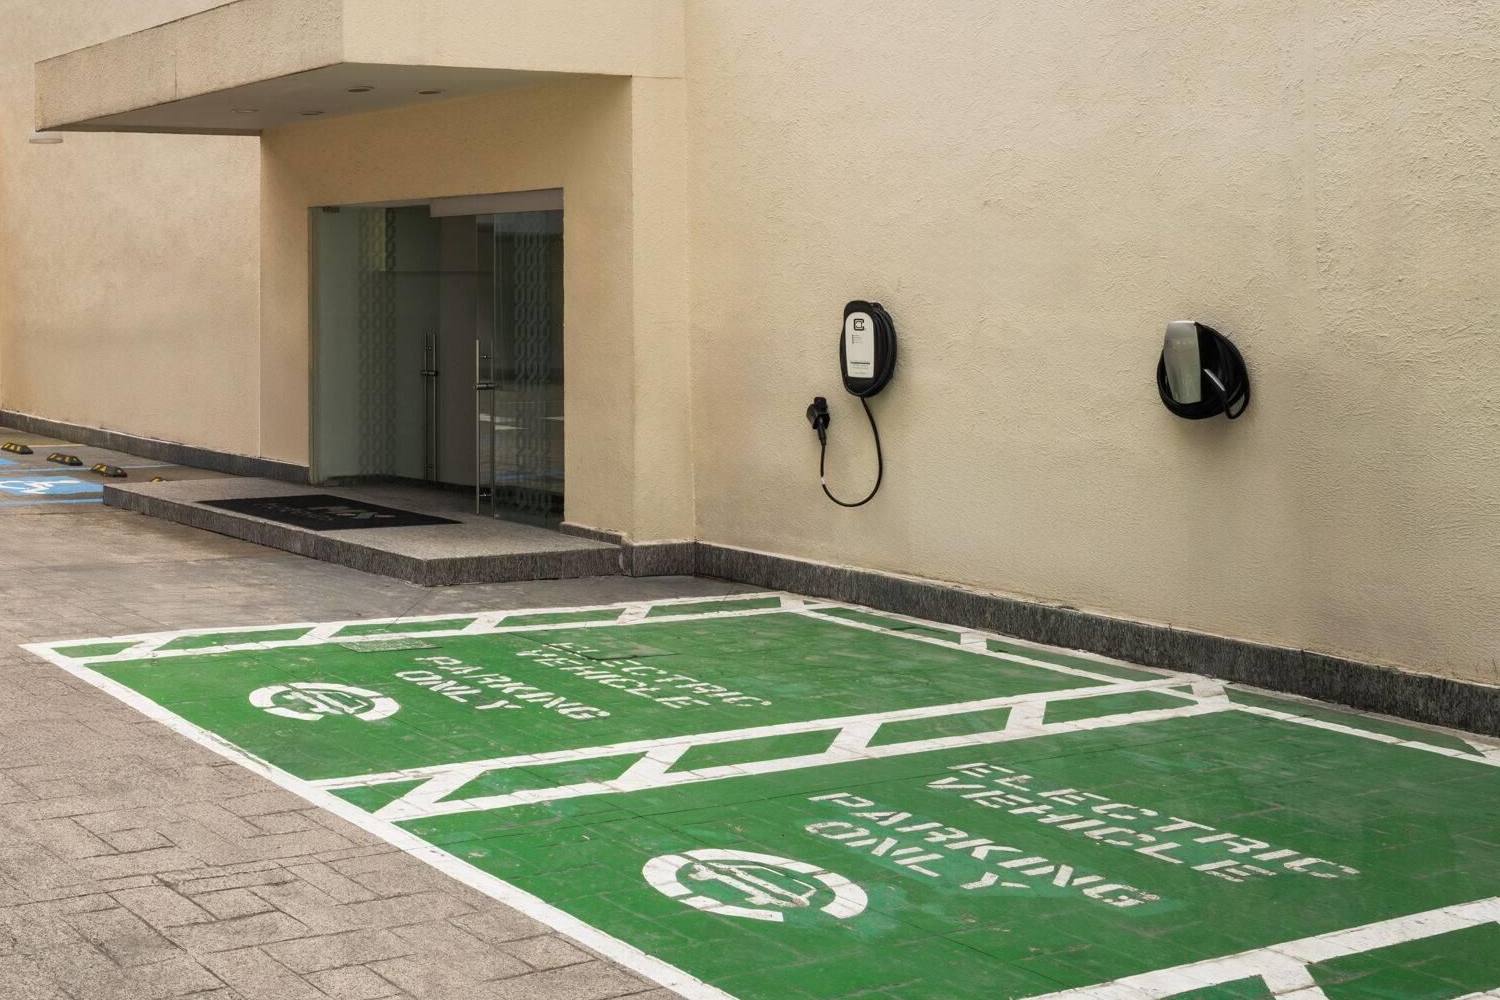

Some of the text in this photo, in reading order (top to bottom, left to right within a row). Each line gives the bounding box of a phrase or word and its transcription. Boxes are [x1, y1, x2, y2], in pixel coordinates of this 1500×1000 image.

[395, 670, 523, 711] ONLY
[415, 656, 611, 720] PARKING
[515, 649, 711, 709] VEHICLE
[542, 642, 772, 707] ELECTRIC
[808, 792, 1161, 908] PARKING
[925, 777, 1277, 883] VEHICLE
[947, 762, 1360, 879] ELECTRIC
[804, 821, 1031, 890] ONLY
